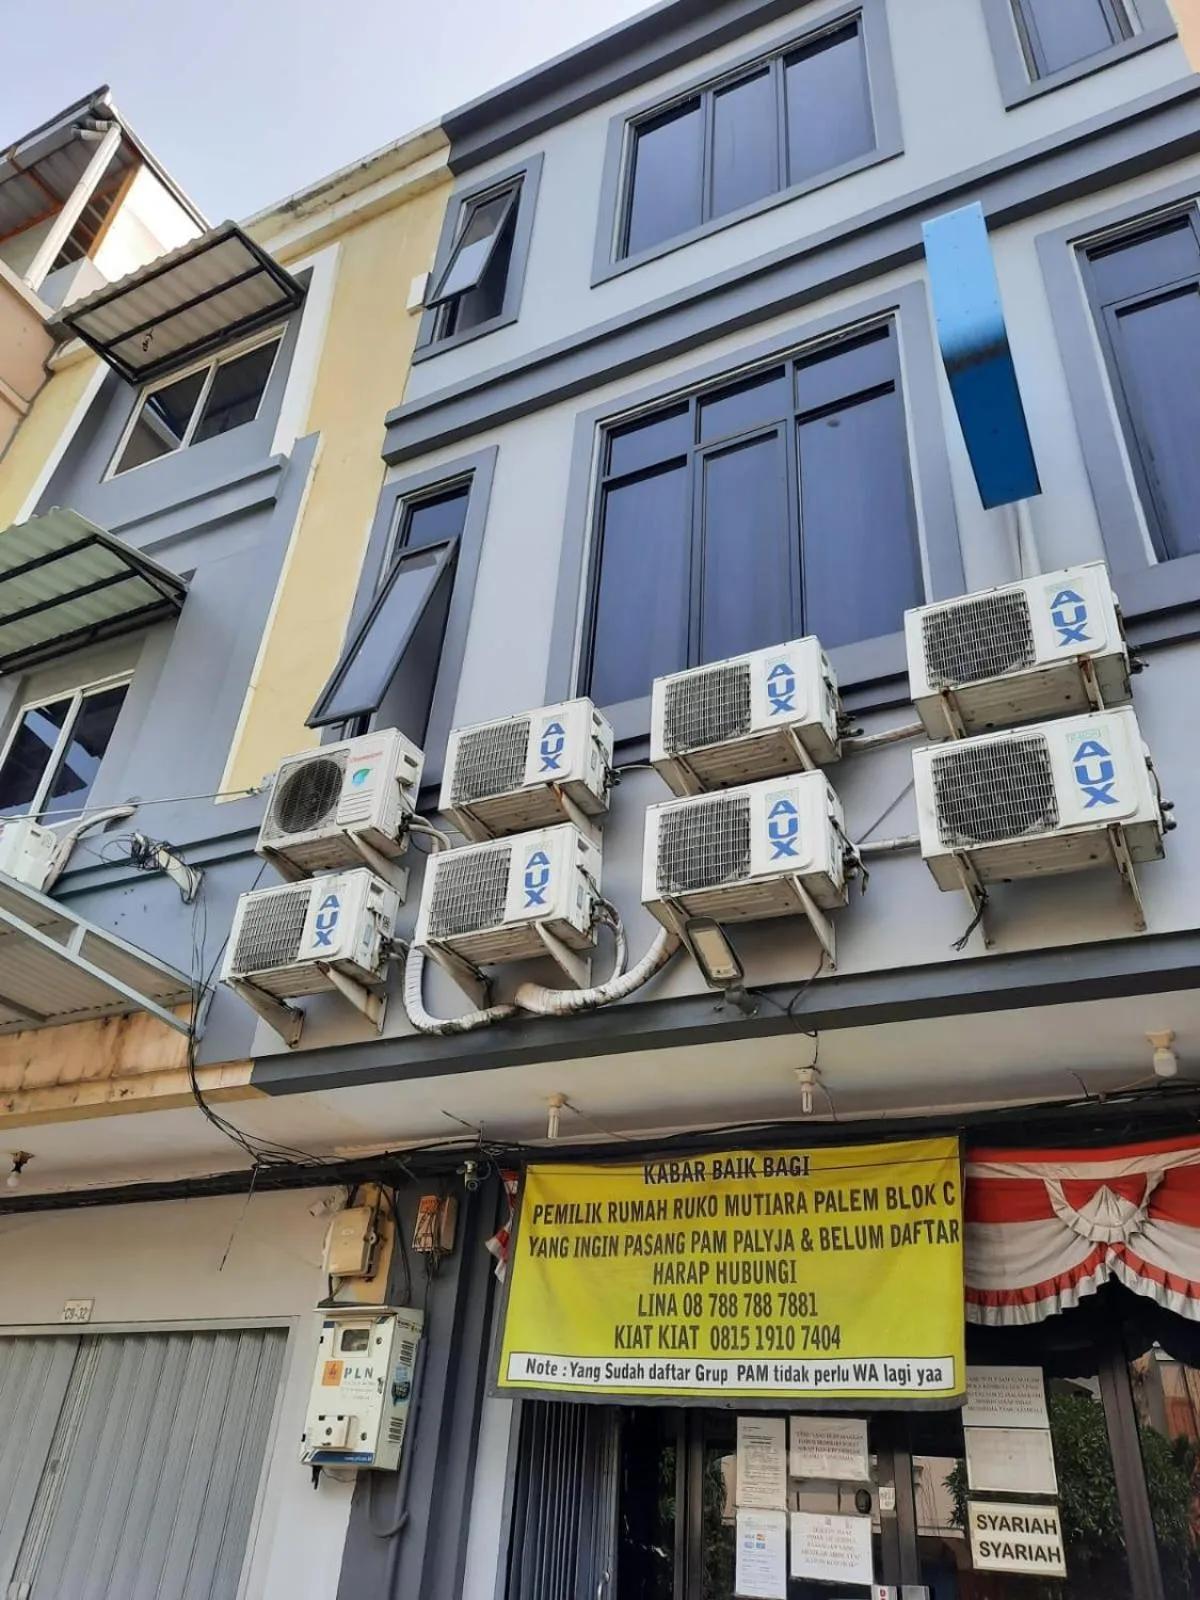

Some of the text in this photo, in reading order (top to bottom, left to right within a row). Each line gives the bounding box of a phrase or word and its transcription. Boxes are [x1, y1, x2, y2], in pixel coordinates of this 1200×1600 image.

[1050, 589, 1093, 647] AUX
[767, 663, 796, 716] AUX
[539, 722, 565, 773] AUX
[1072, 740, 1120, 810] AUX
[767, 800, 799, 861] AUX
[524, 851, 551, 908] AUX
[313, 894, 340, 948] AUX
[644, 1156, 809, 1184] KABAR BAIK BAGI
[533, 1181, 955, 1224] PEMILIK RUMAH RUKO MUTIARA PALEM BLOK C
[529, 1219, 960, 1258] YANG INGIN PASANG PAM PALYJA & BELUM DAFTAR
[653, 1259, 797, 1285] HARAP HUBUNGI
[638, 1292, 818, 1318] LINA 08 788 788 7881
[614, 1325, 840, 1350] KIAT KIAT 0815 1910 7404
[344, 1367, 374, 1379] PLN
[526, 1358, 558, 1376] Note
[570, 1361, 600, 1382] Yang
[604, 1362, 645, 1379] Sudah
[650, 1363, 690, 1381] daftar
[695, 1364, 729, 1384] Grup
[737, 1364, 769, 1382] PAM
[774, 1364, 809, 1382] tidak
[814, 1364, 849, 1385] perlu
[852, 1363, 879, 1381] WA
[884, 1363, 911, 1385] lagi
[917, 1366, 942, 1386] yaa
[976, 1514, 1057, 1536] SYARIAH
[979, 1541, 1061, 1564] SYARIAH
